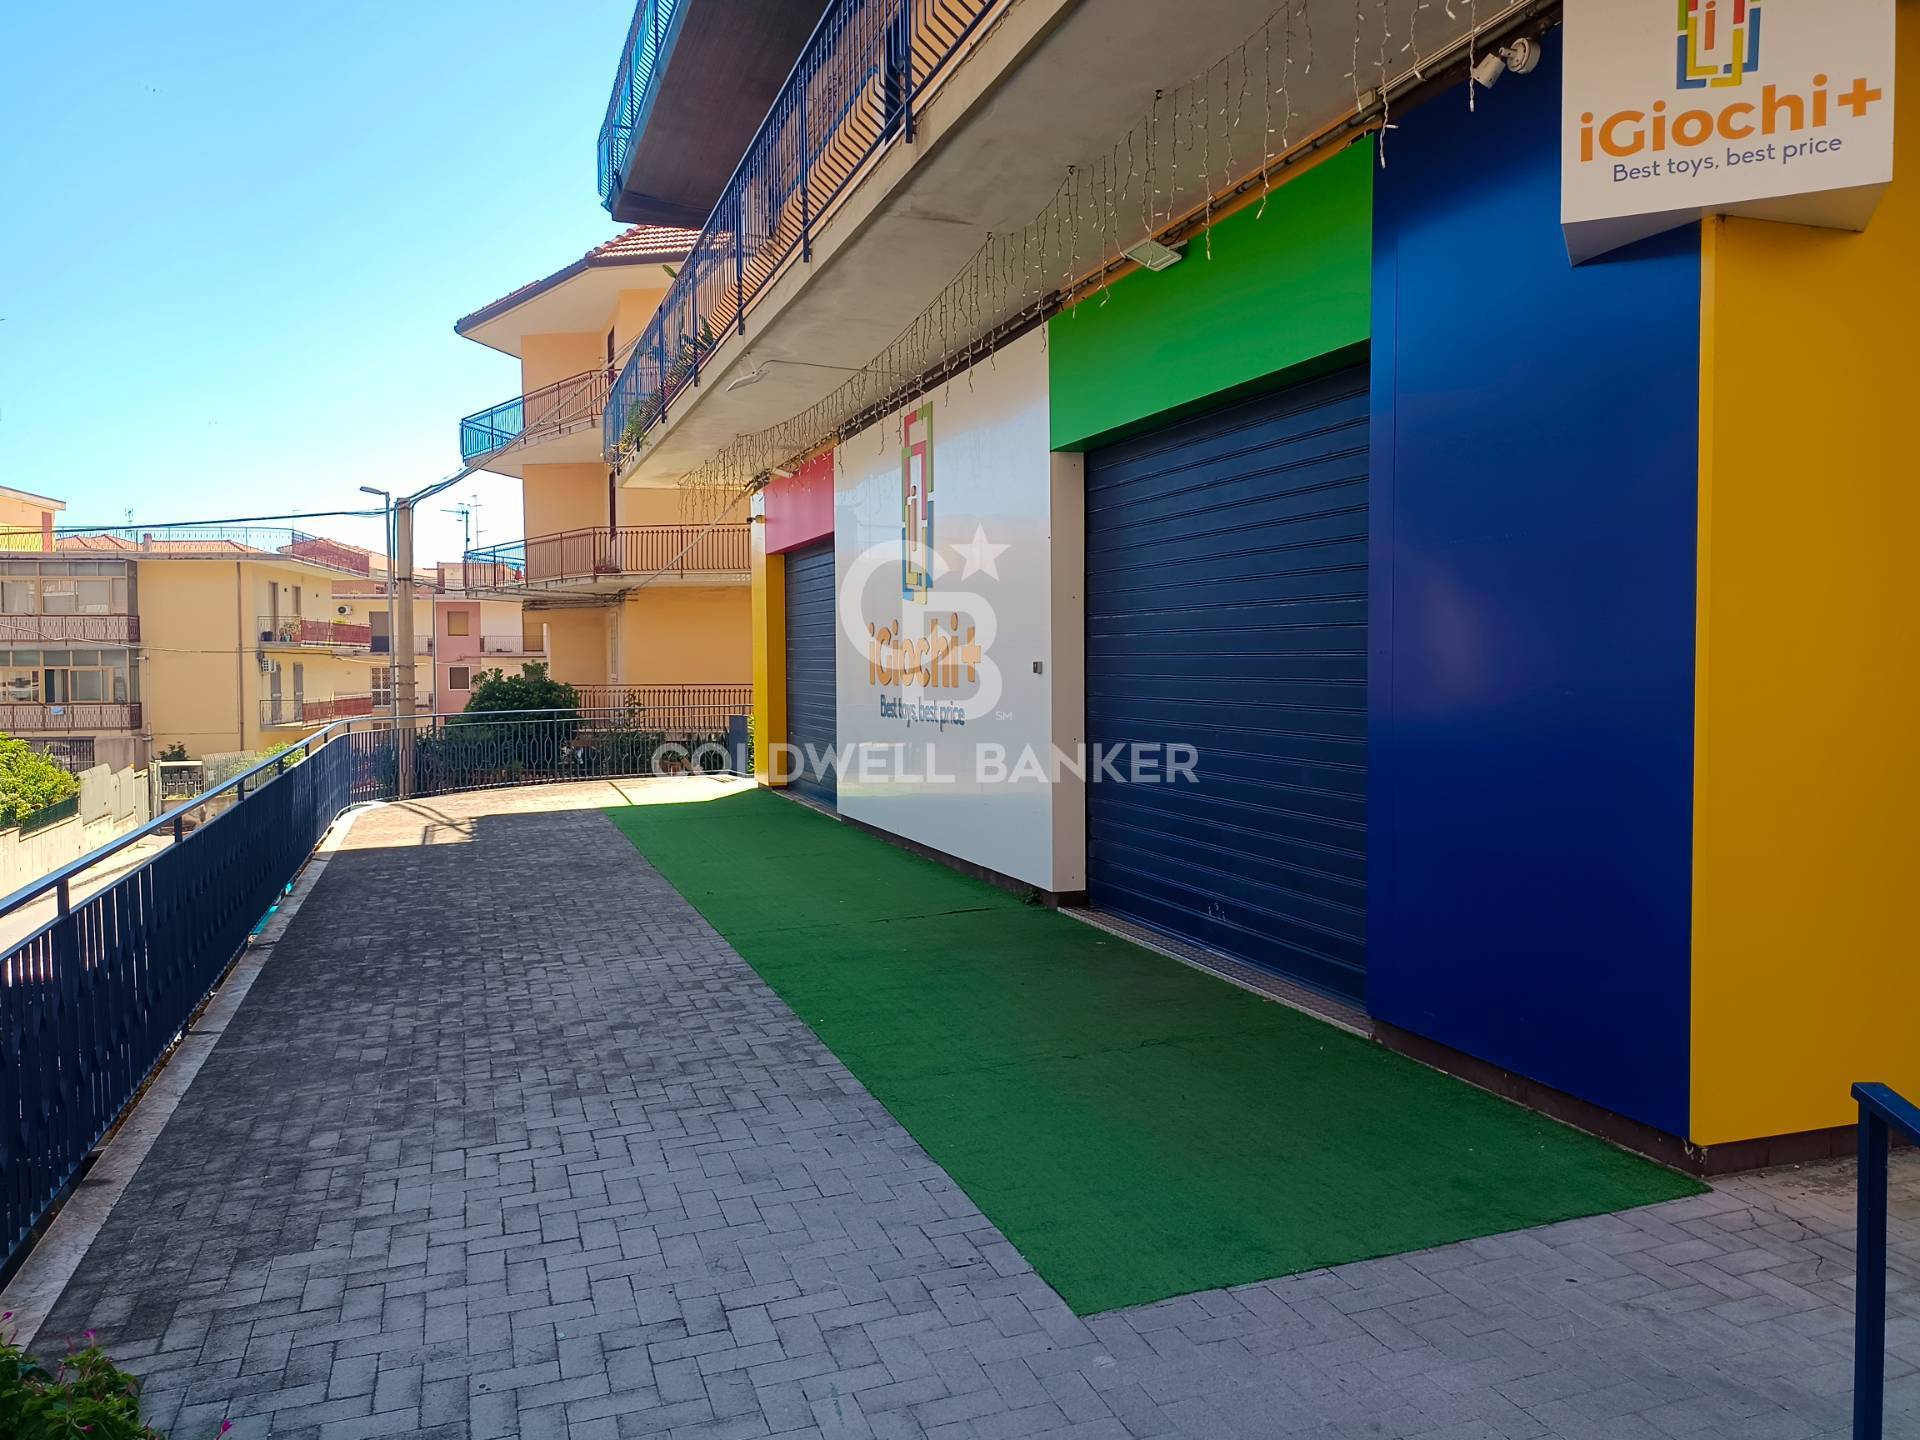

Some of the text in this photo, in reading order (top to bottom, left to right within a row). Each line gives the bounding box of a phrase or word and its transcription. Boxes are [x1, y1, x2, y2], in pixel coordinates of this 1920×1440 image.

[1580, 73, 1882, 162] iGiochi+
[1613, 137, 1842, 182] Best toys, best price
[880, 694, 898, 719] Best
[918, 696, 937, 722] best
[939, 700, 966, 732] price
